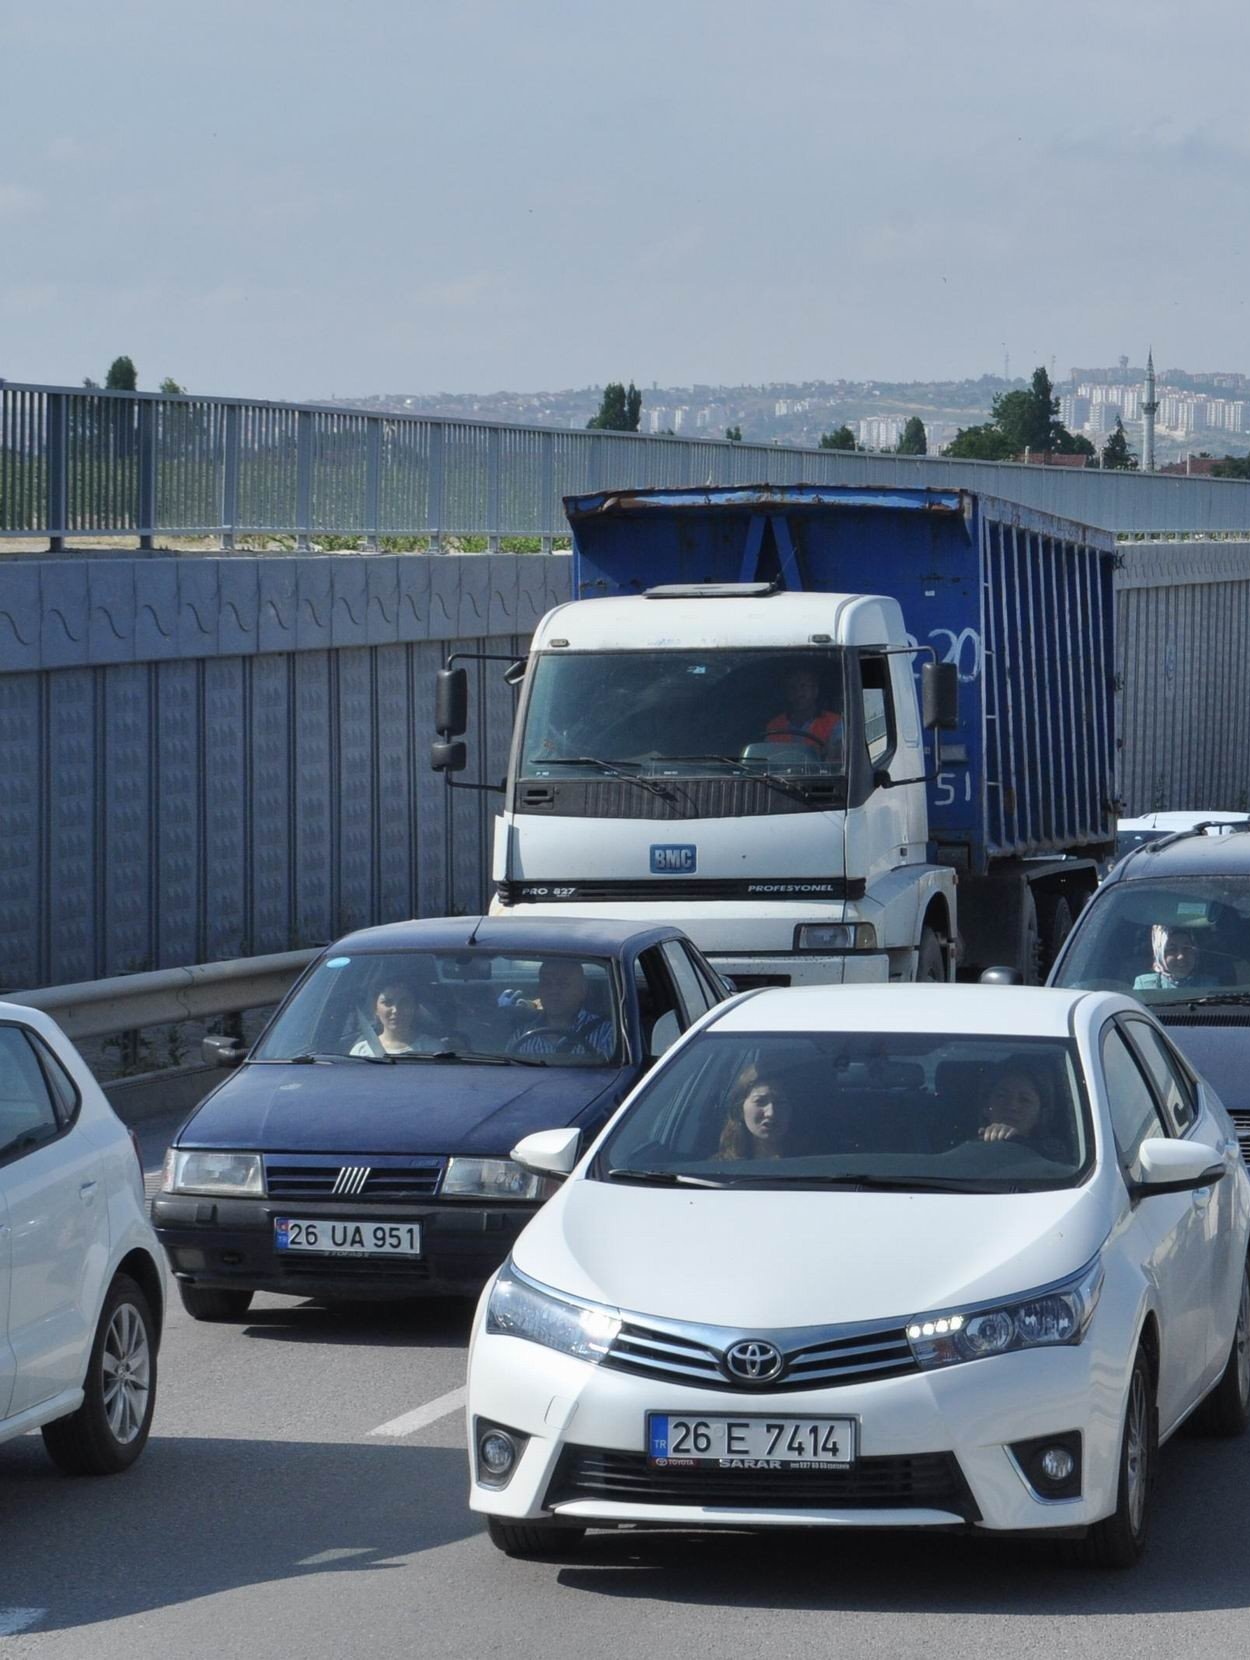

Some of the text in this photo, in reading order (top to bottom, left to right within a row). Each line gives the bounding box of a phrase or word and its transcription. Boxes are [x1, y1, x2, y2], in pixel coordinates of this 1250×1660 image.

[655, 849, 692, 869] BMC
[522, 887, 576, 895] PRO 827
[747, 884, 834, 892] PROFESYONEL
[290, 1224, 415, 1250] 26 UA 951
[672, 1421, 840, 1457] 26 E 7414
[655, 1440, 667, 1449] TR
[719, 1459, 782, 1469] SARAR
